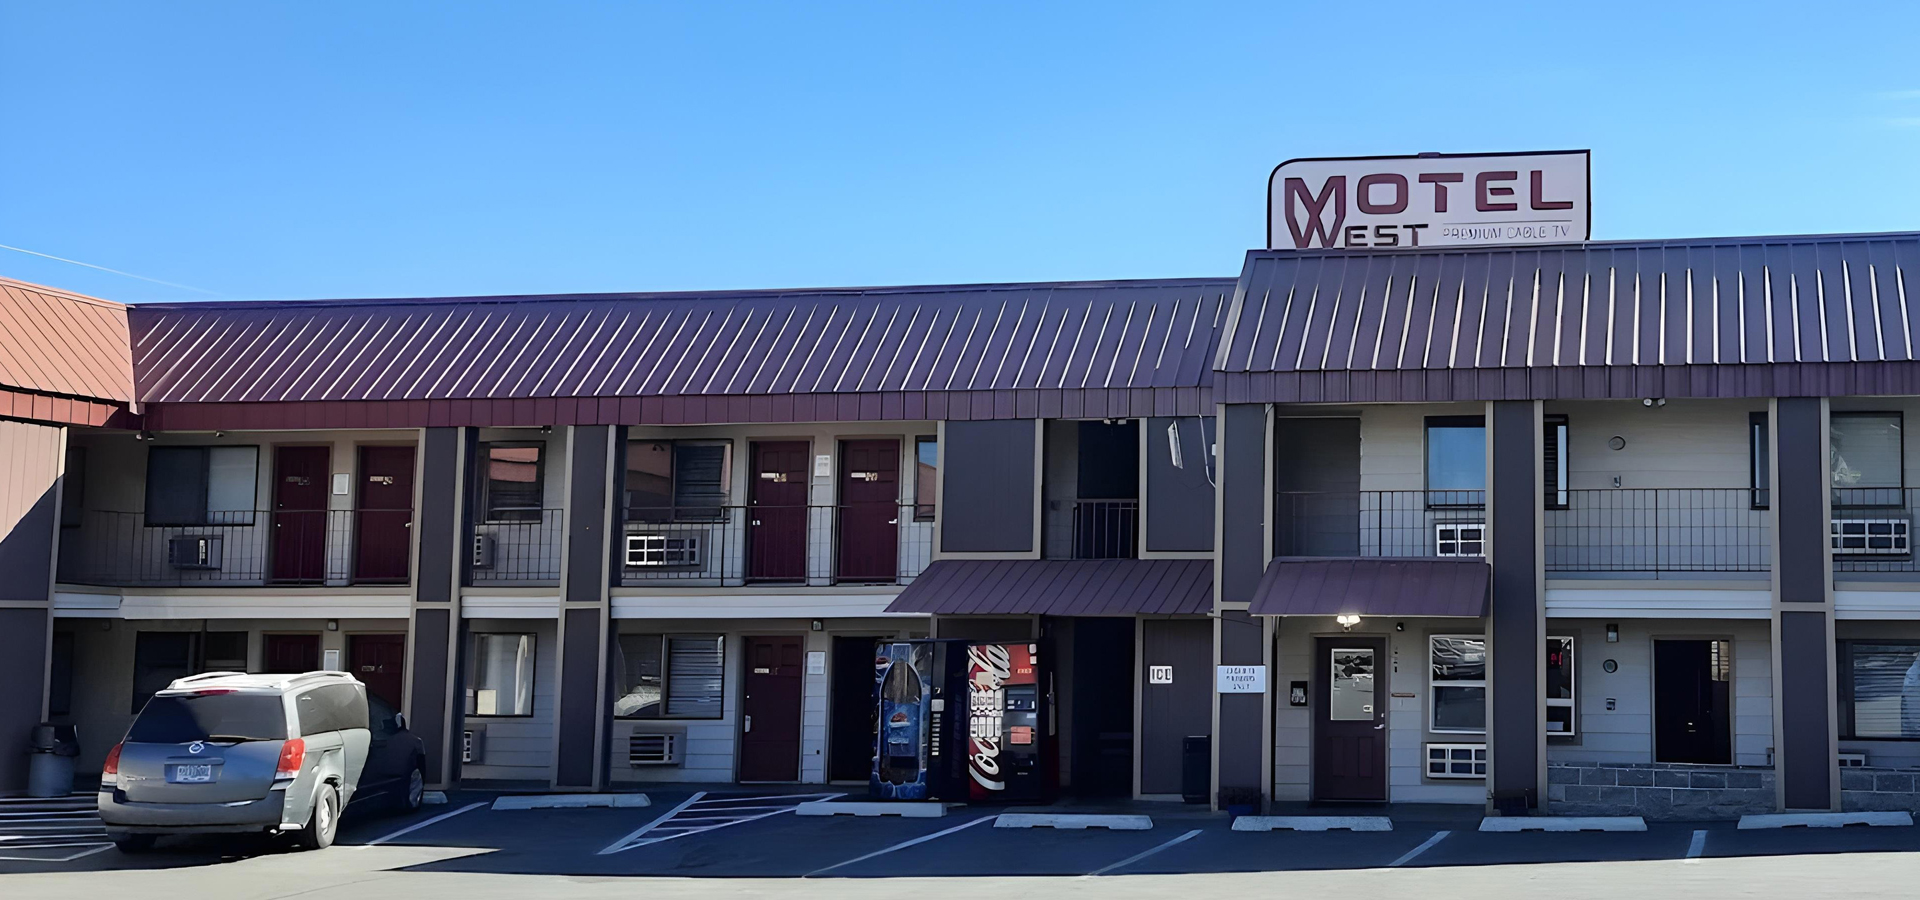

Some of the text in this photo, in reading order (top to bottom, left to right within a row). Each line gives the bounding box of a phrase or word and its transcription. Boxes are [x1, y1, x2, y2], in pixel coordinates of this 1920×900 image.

[1285, 170, 1574, 216] MOTEL
[1285, 212, 1429, 249] WEST
[1552, 225, 1570, 237] TV
